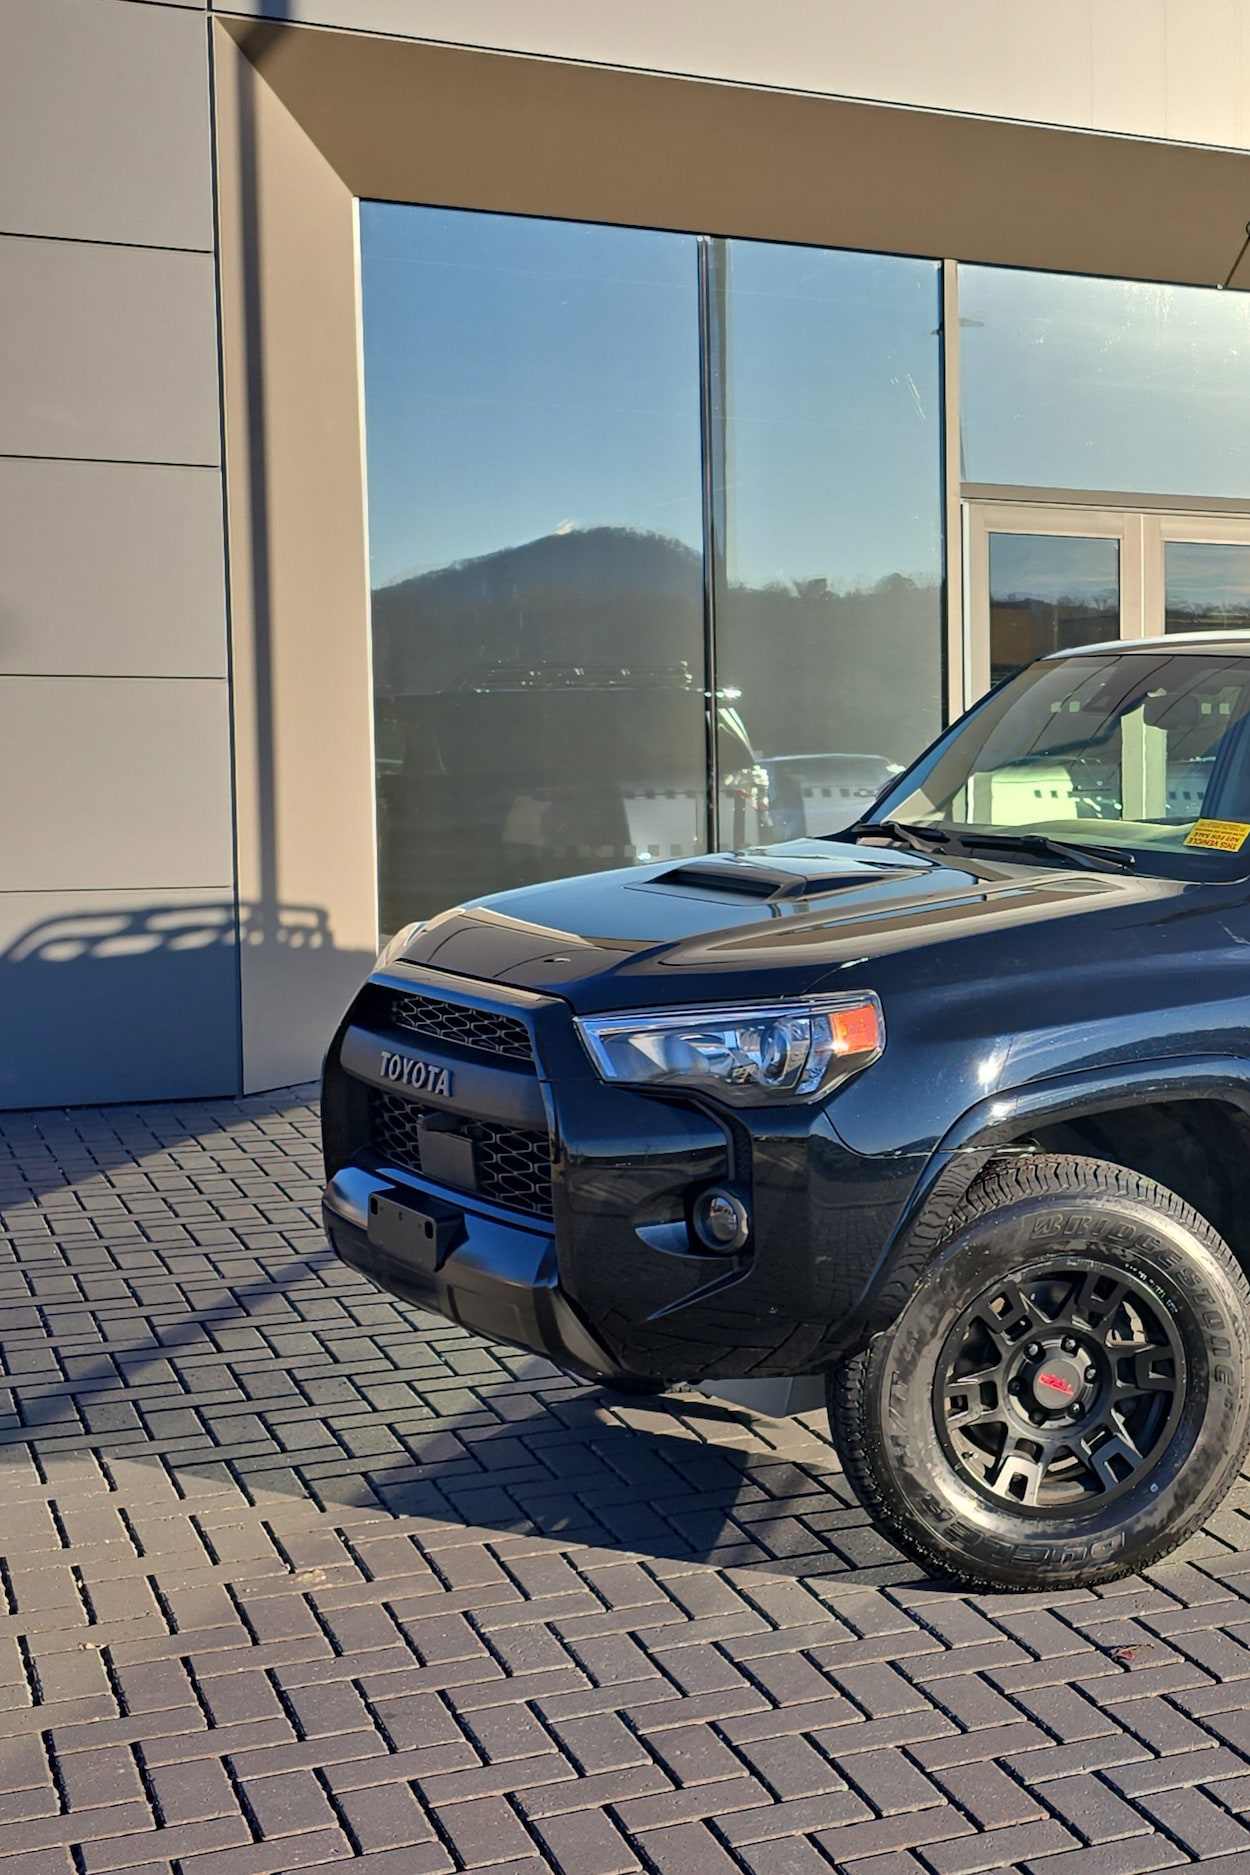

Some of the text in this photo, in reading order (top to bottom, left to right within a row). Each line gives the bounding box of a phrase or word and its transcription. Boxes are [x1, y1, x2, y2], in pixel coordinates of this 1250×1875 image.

[380, 1050, 452, 1097] TOYOTA
[1030, 1213, 1234, 1387] BRIDGESTONE
[919, 1491, 1127, 1567] DUELER
